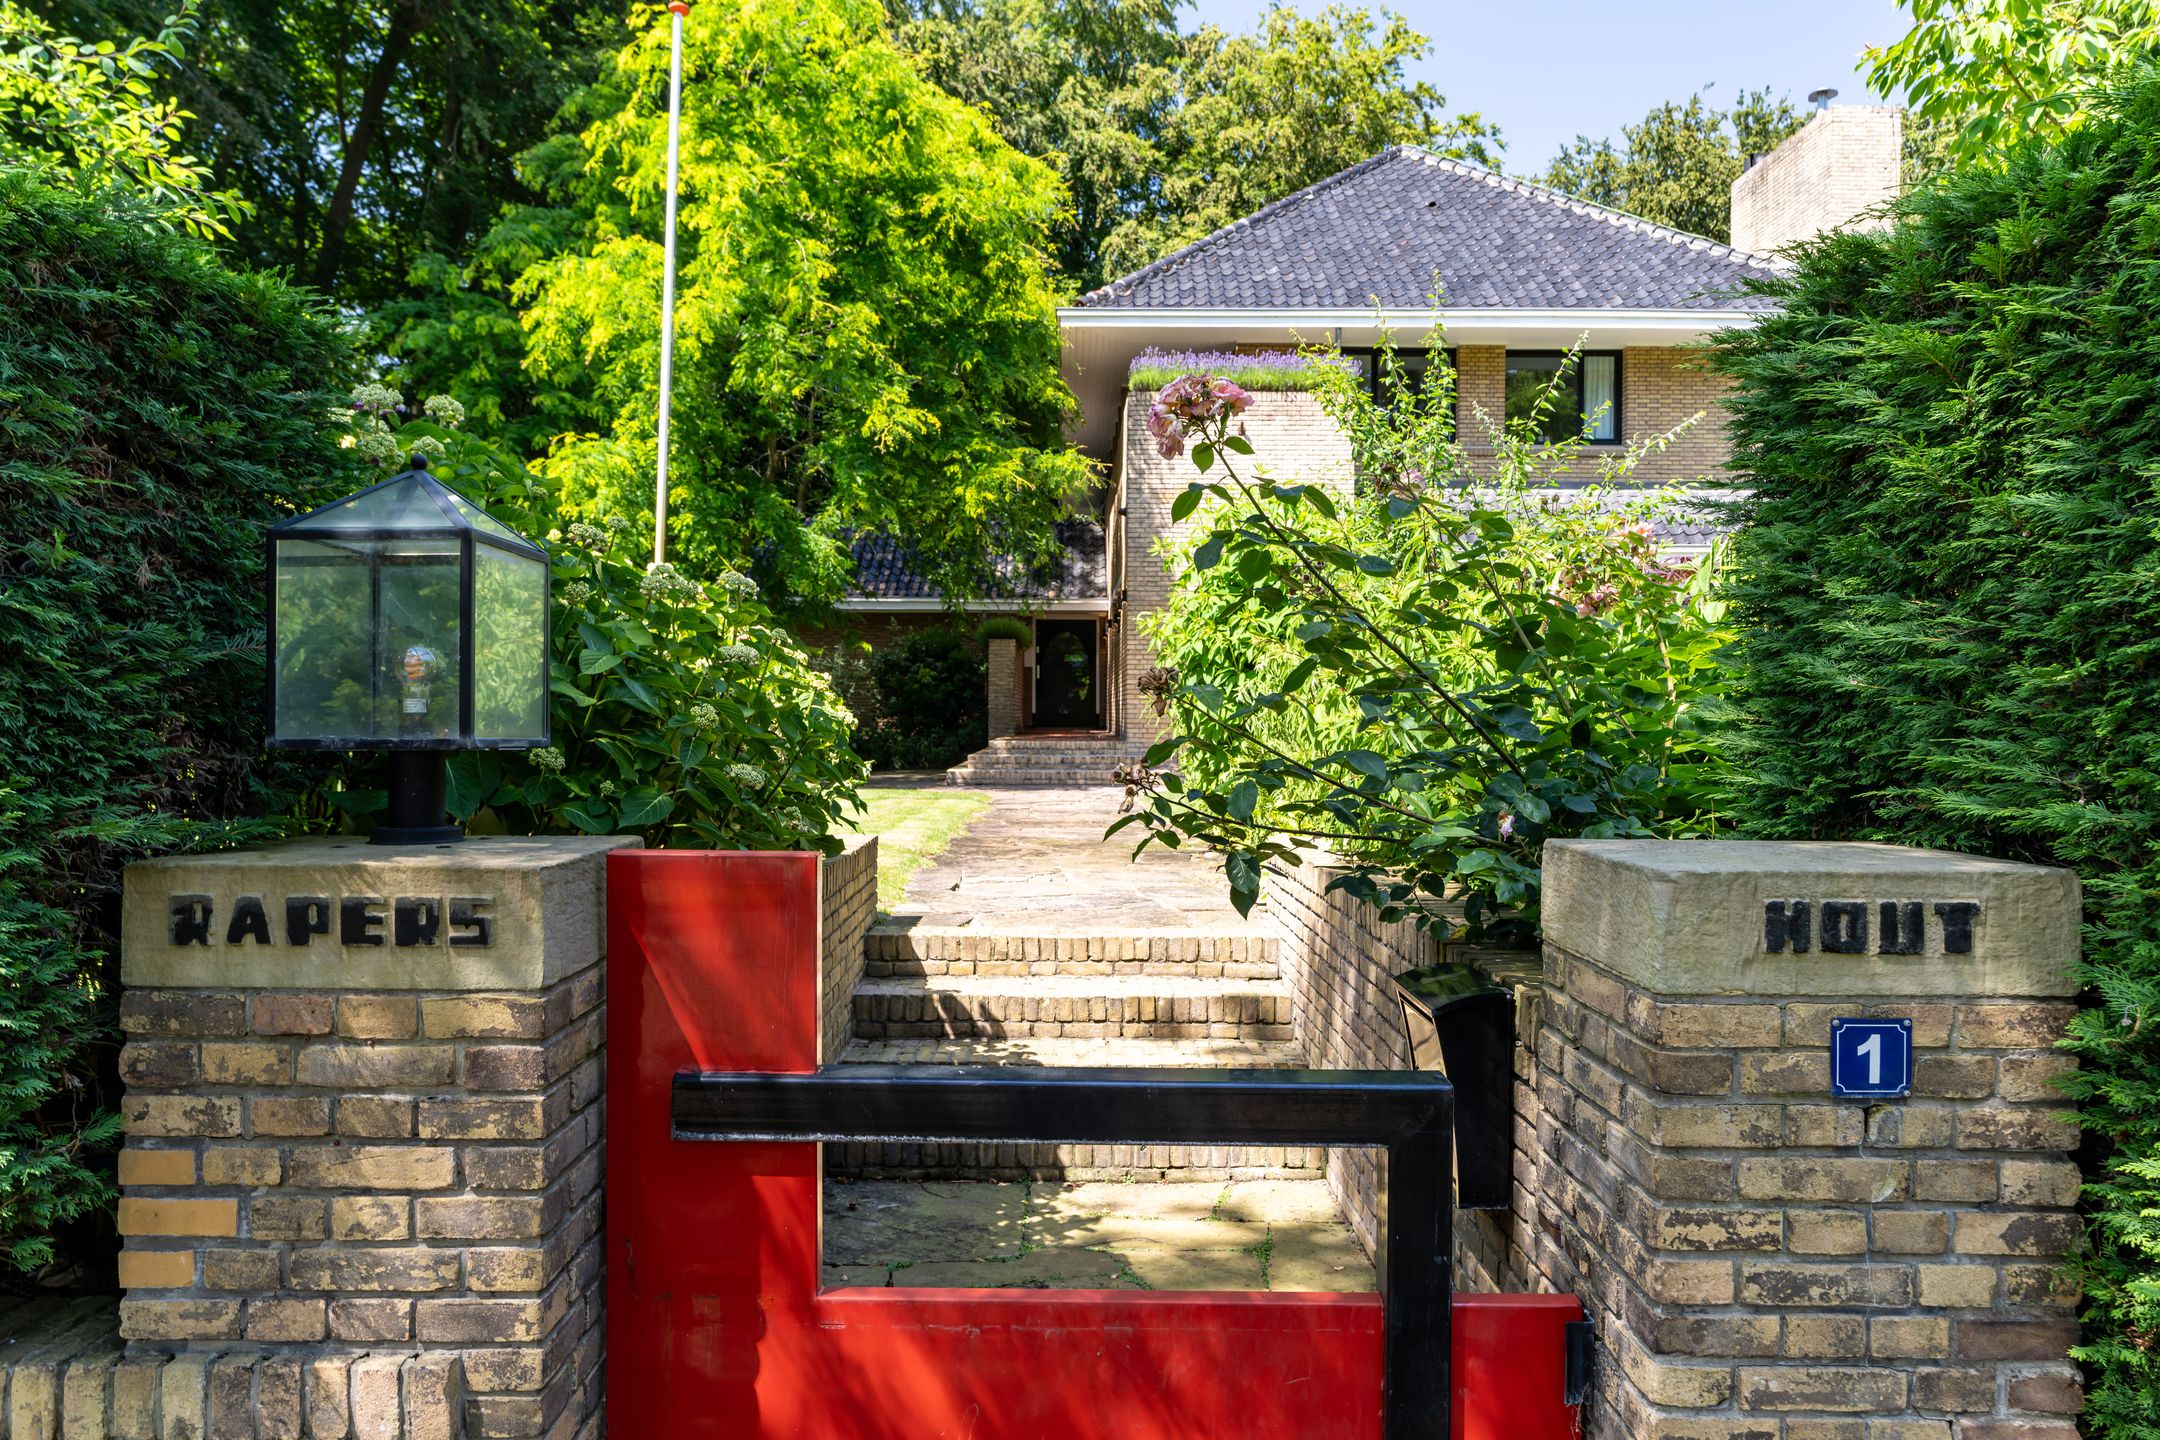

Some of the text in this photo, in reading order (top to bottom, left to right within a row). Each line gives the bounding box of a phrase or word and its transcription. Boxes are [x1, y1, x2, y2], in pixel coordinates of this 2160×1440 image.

[169, 894, 494, 946] RAPERS
[1765, 900, 1981, 954] HOUT
[1857, 1033, 1881, 1084] 1
